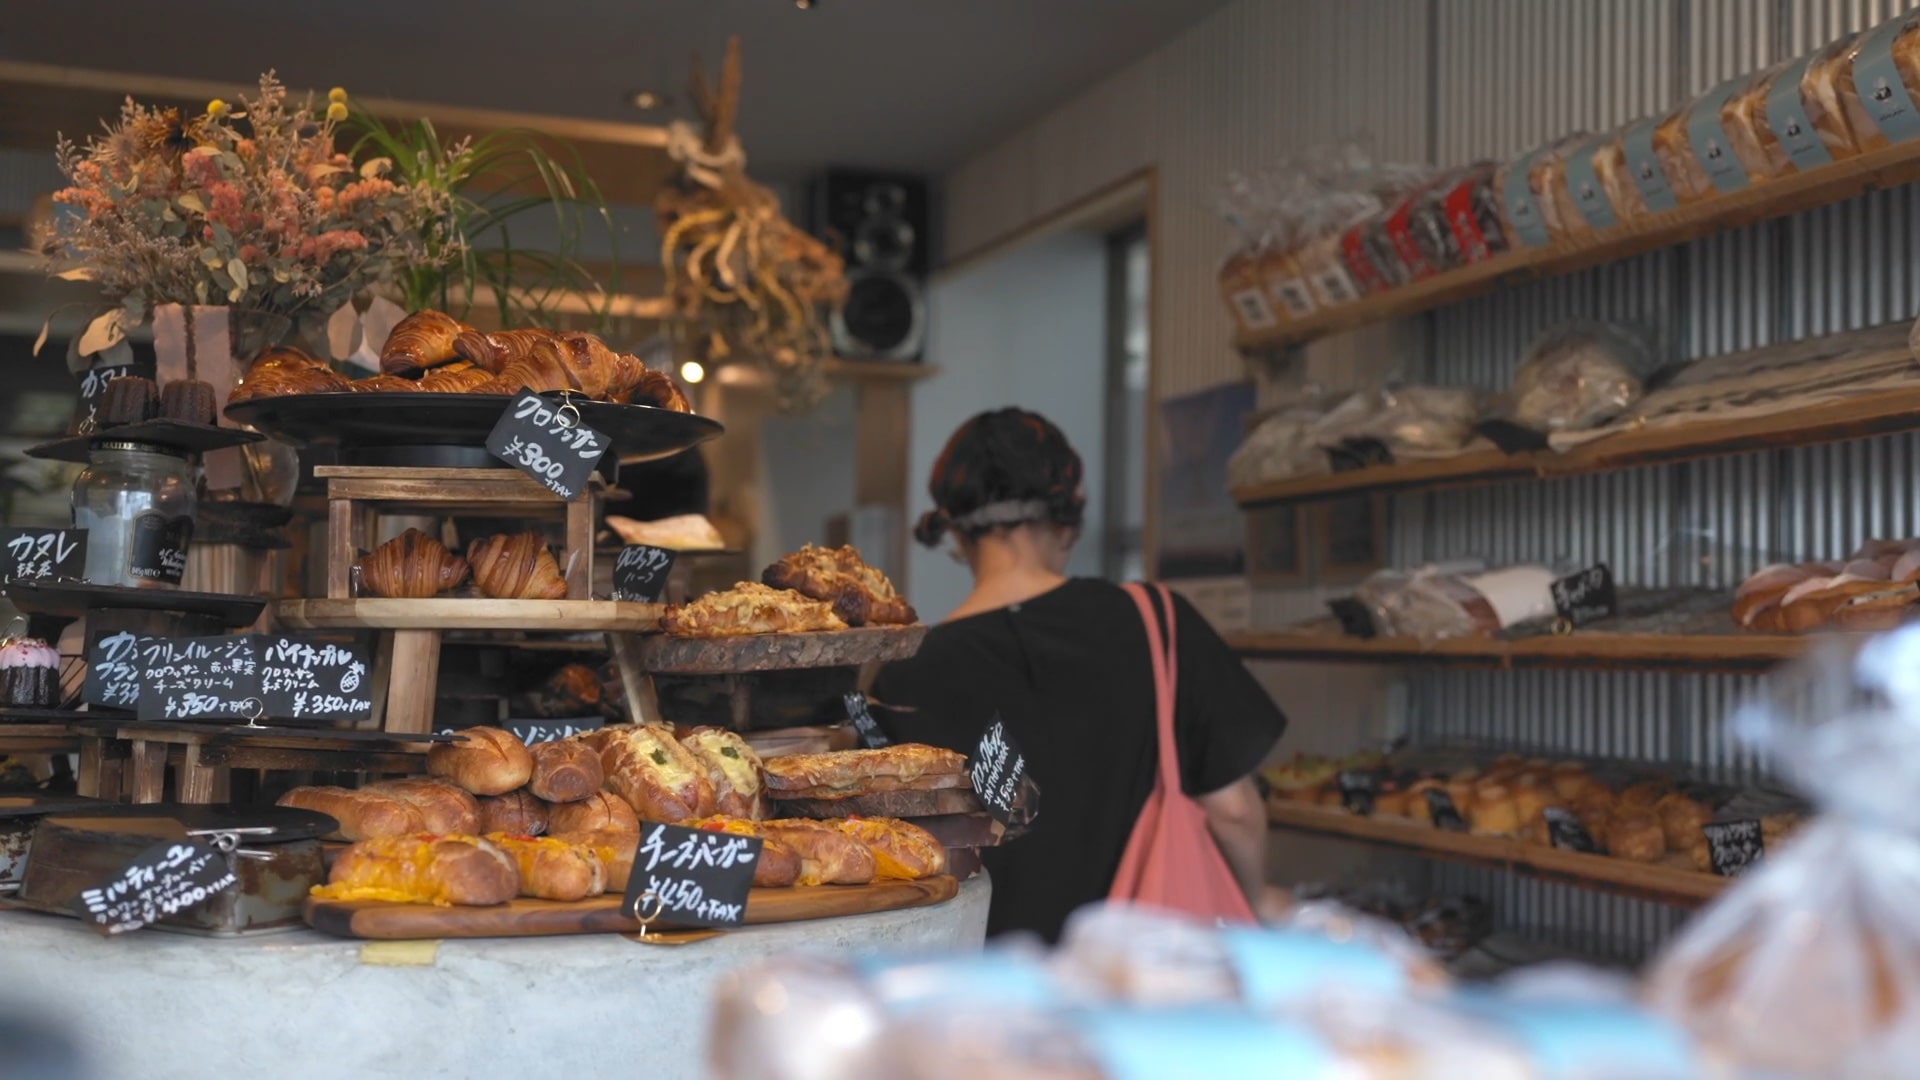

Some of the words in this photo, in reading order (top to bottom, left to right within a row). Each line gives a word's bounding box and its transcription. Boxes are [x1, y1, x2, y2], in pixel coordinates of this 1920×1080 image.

[514, 395, 602, 458] クロワッサン
[7, 531, 79, 565] カヌレ
[142, 637, 254, 666] フリュイルージュ
[264, 638, 353, 670] パイナップル
[153, 677, 234, 695] チーズクリーム
[640, 823, 755, 873] チーズバーガー
